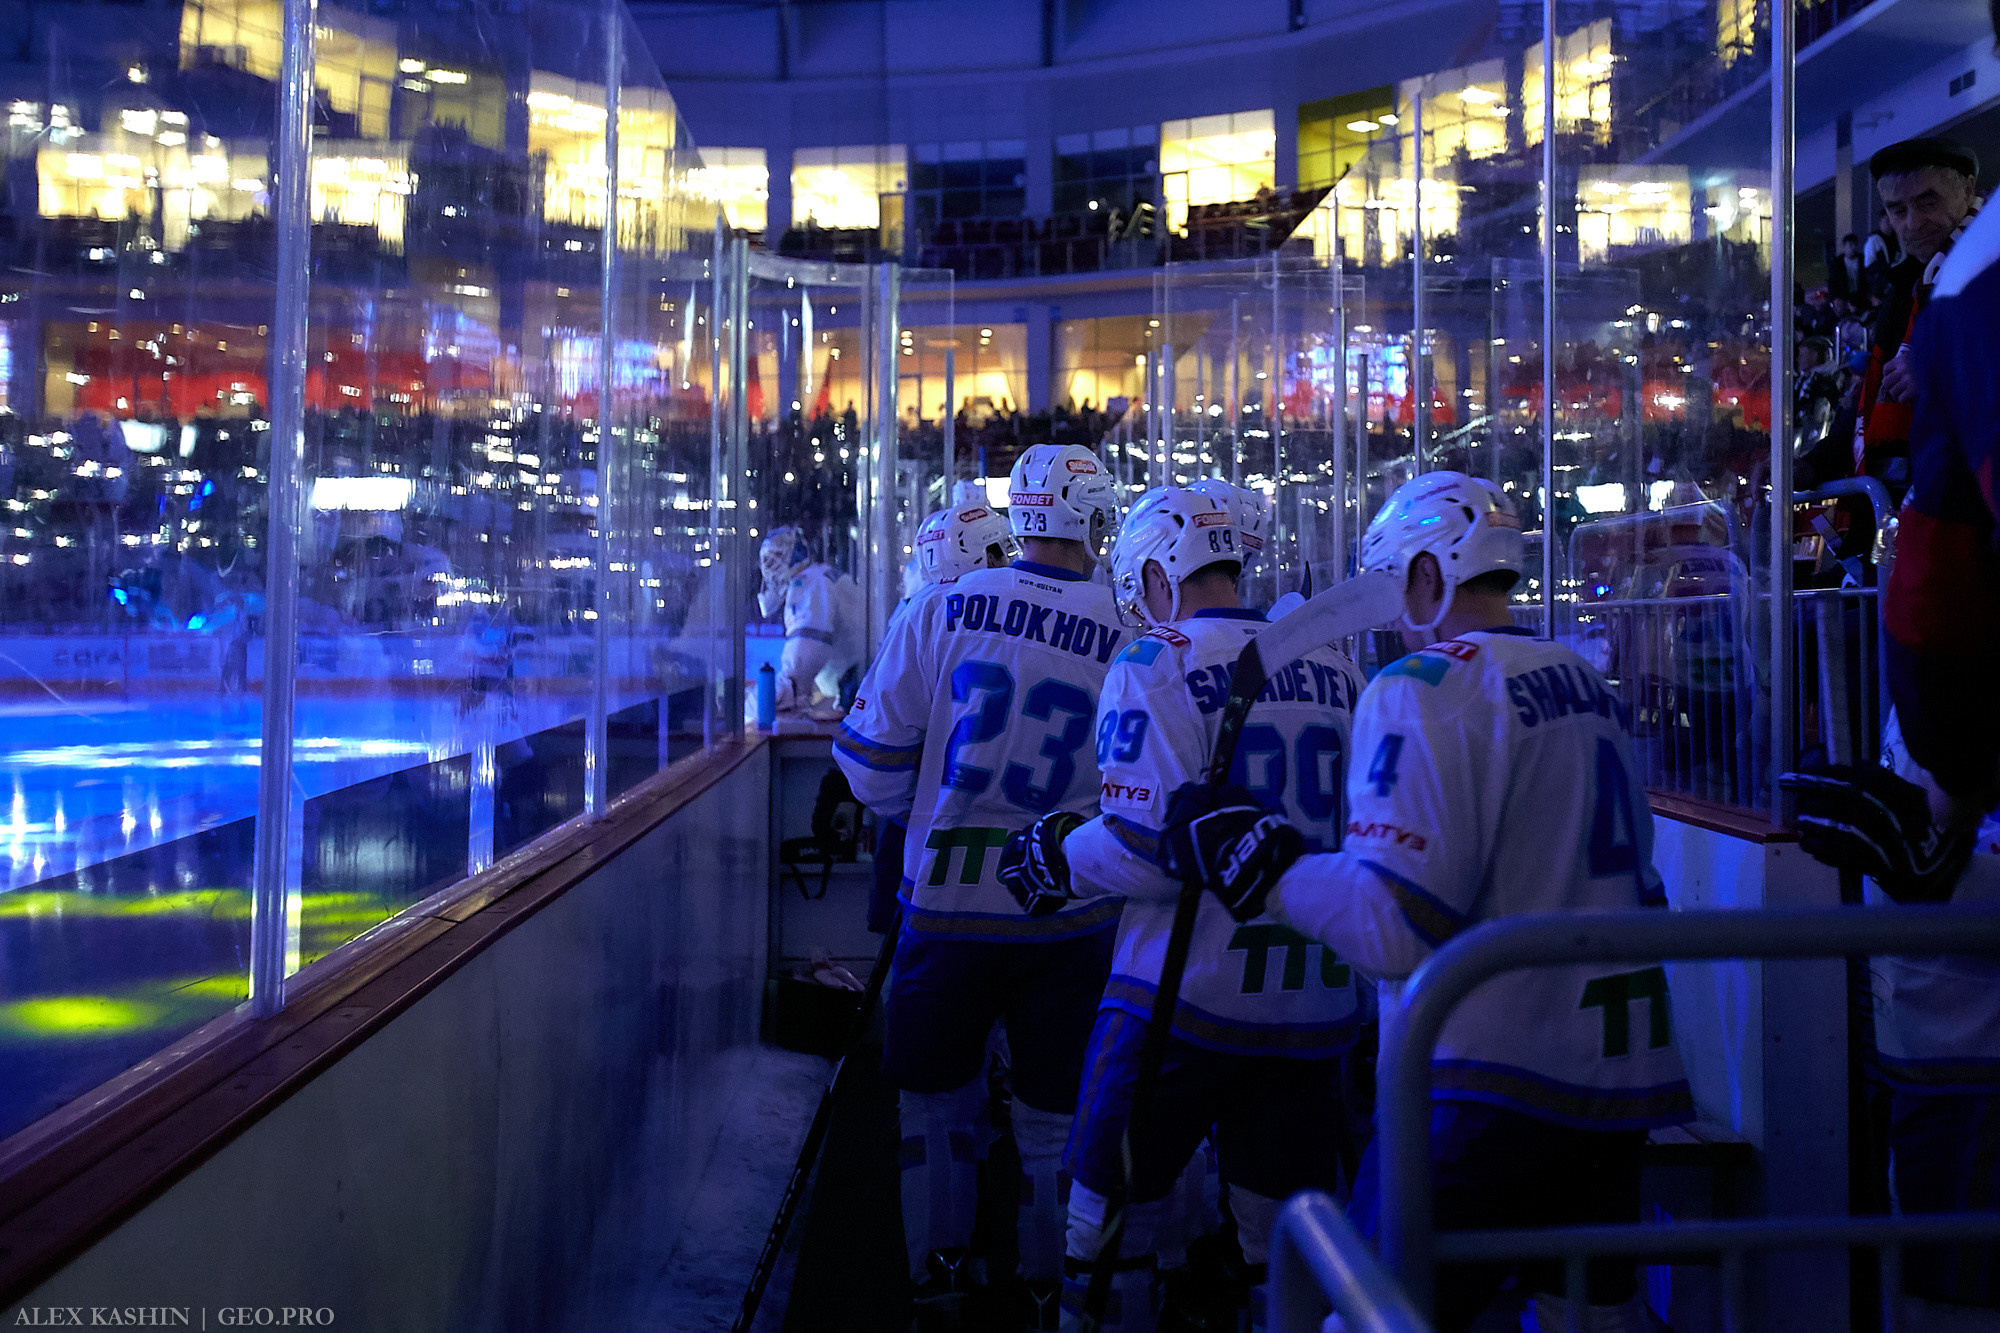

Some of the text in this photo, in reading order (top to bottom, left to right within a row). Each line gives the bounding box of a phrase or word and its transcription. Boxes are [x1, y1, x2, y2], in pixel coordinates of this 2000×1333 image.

[1011, 494, 1053, 506] FONBET
[1022, 511, 1047, 532] 23
[927, 548, 934, 566] 7
[1208, 529, 1234, 553] 89
[946, 593, 1121, 664] POLOKHOV
[941, 659, 1097, 815] 23
[1096, 709, 1150, 765] 89
[1229, 722, 1343, 853] 89
[1368, 733, 1404, 798] 4
